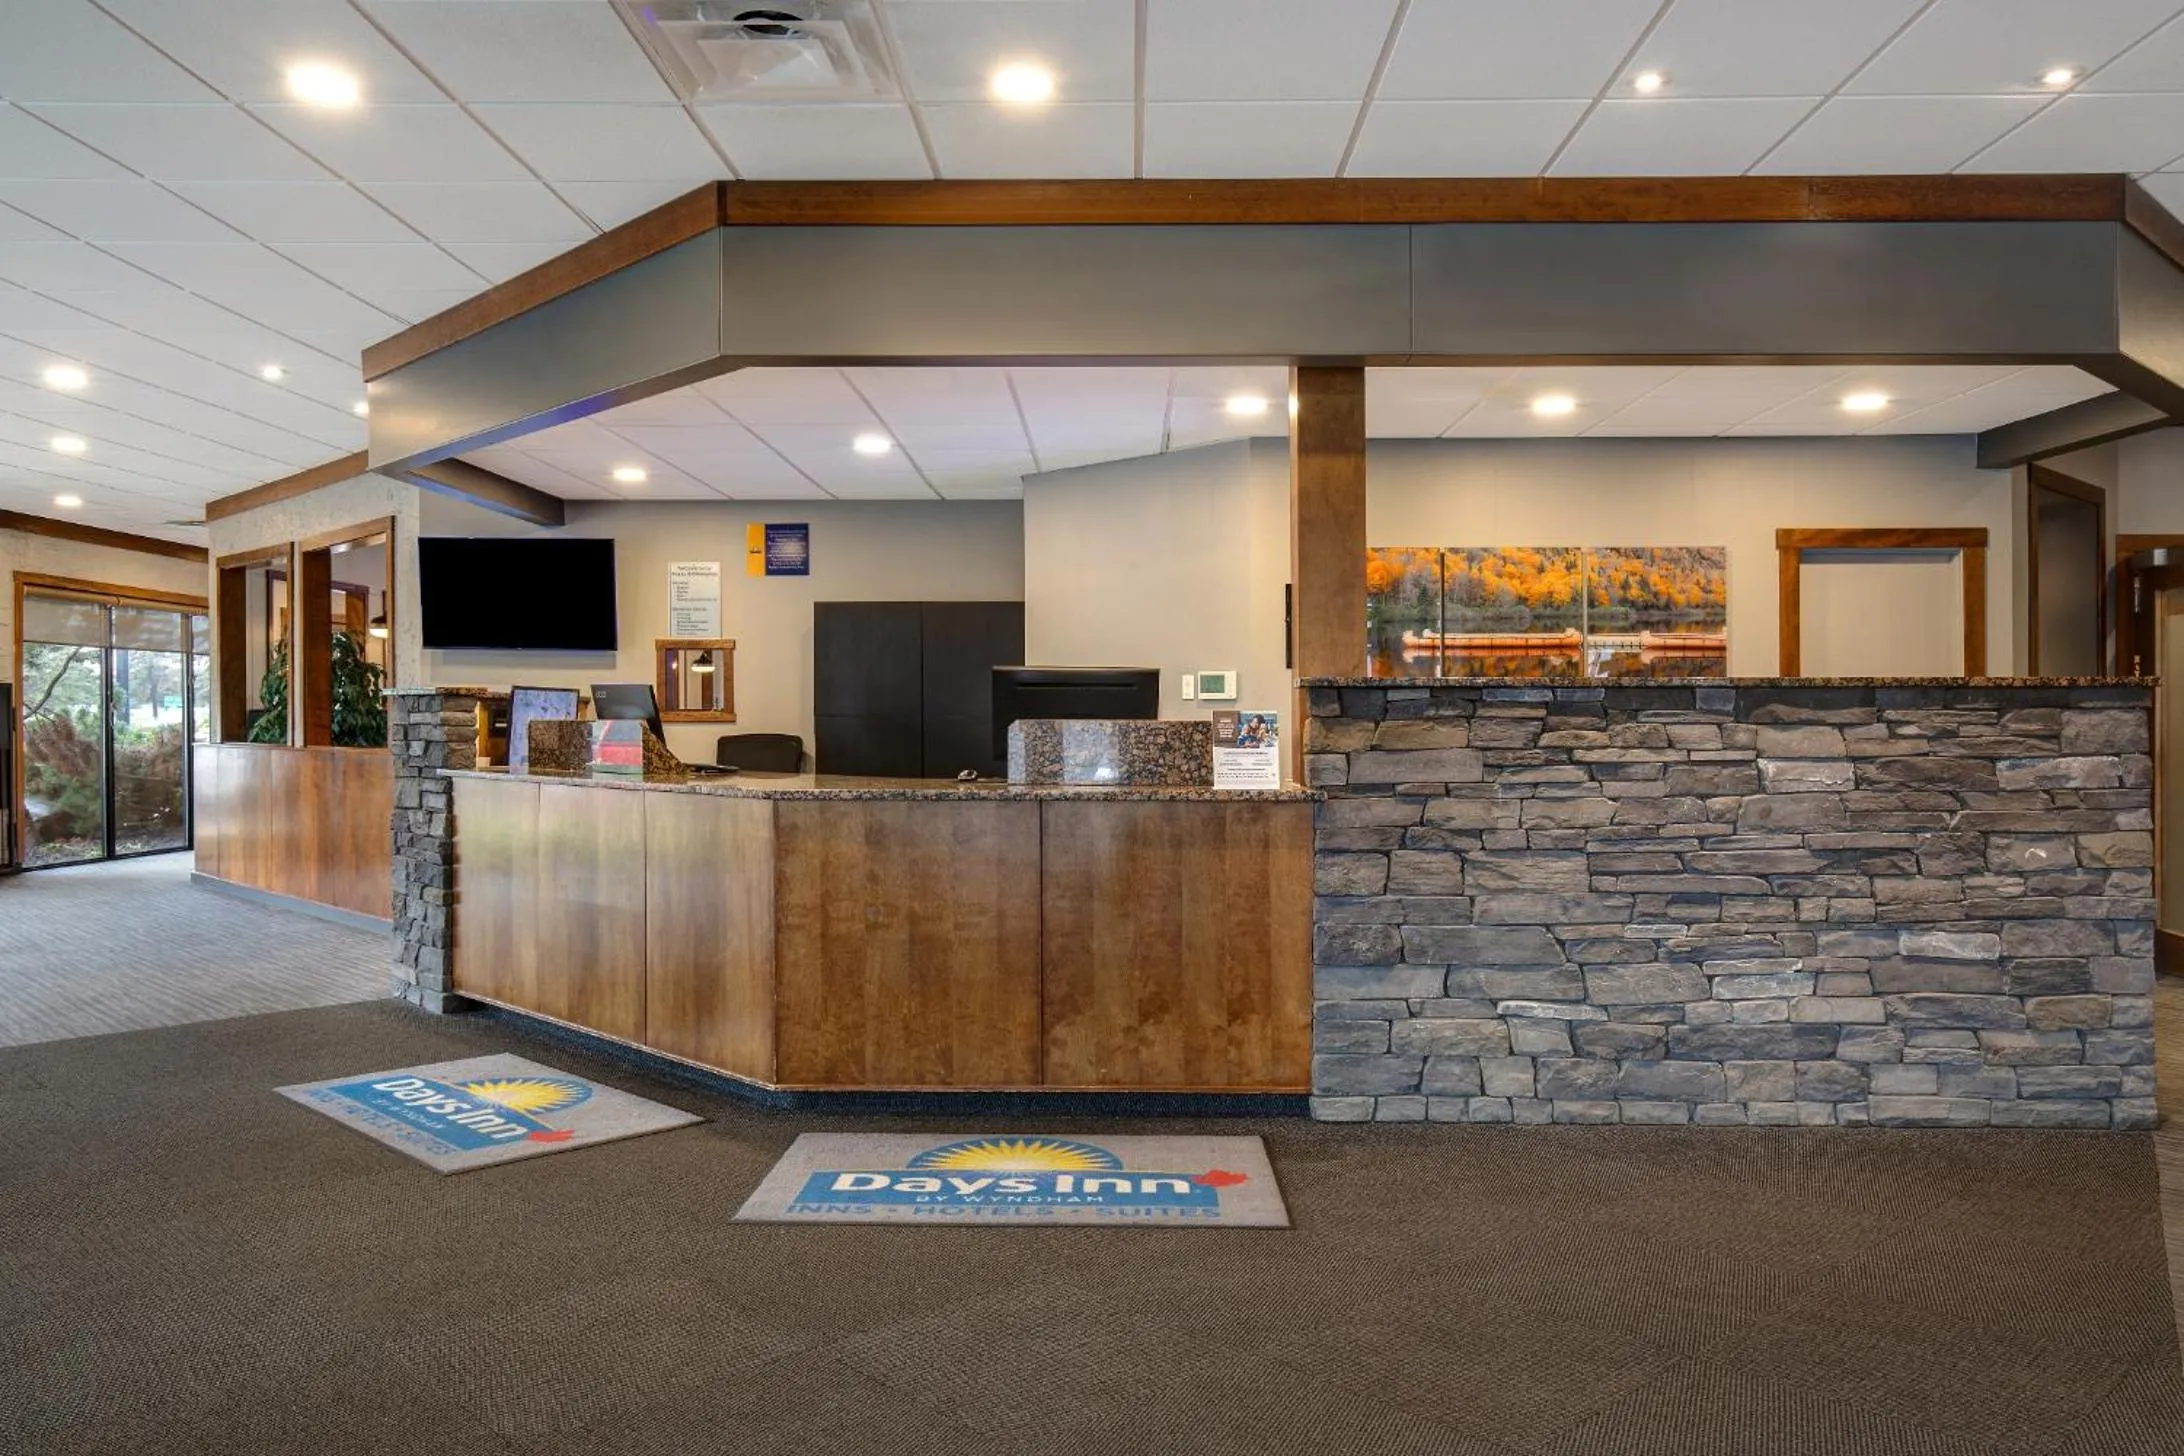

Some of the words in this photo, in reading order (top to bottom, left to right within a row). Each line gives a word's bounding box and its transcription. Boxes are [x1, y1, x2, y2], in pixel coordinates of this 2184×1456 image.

[373, 1078, 472, 1114] Days
[446, 1108, 528, 1138] Inn
[831, 1173, 1037, 1195] Days
[1055, 1175, 1190, 1194] Inn
[916, 1195, 947, 1203] BY
[786, 1203, 872, 1214] INNS
[912, 1205, 1053, 1216] HOTELS
[1096, 1206, 1220, 1217] SUITES
